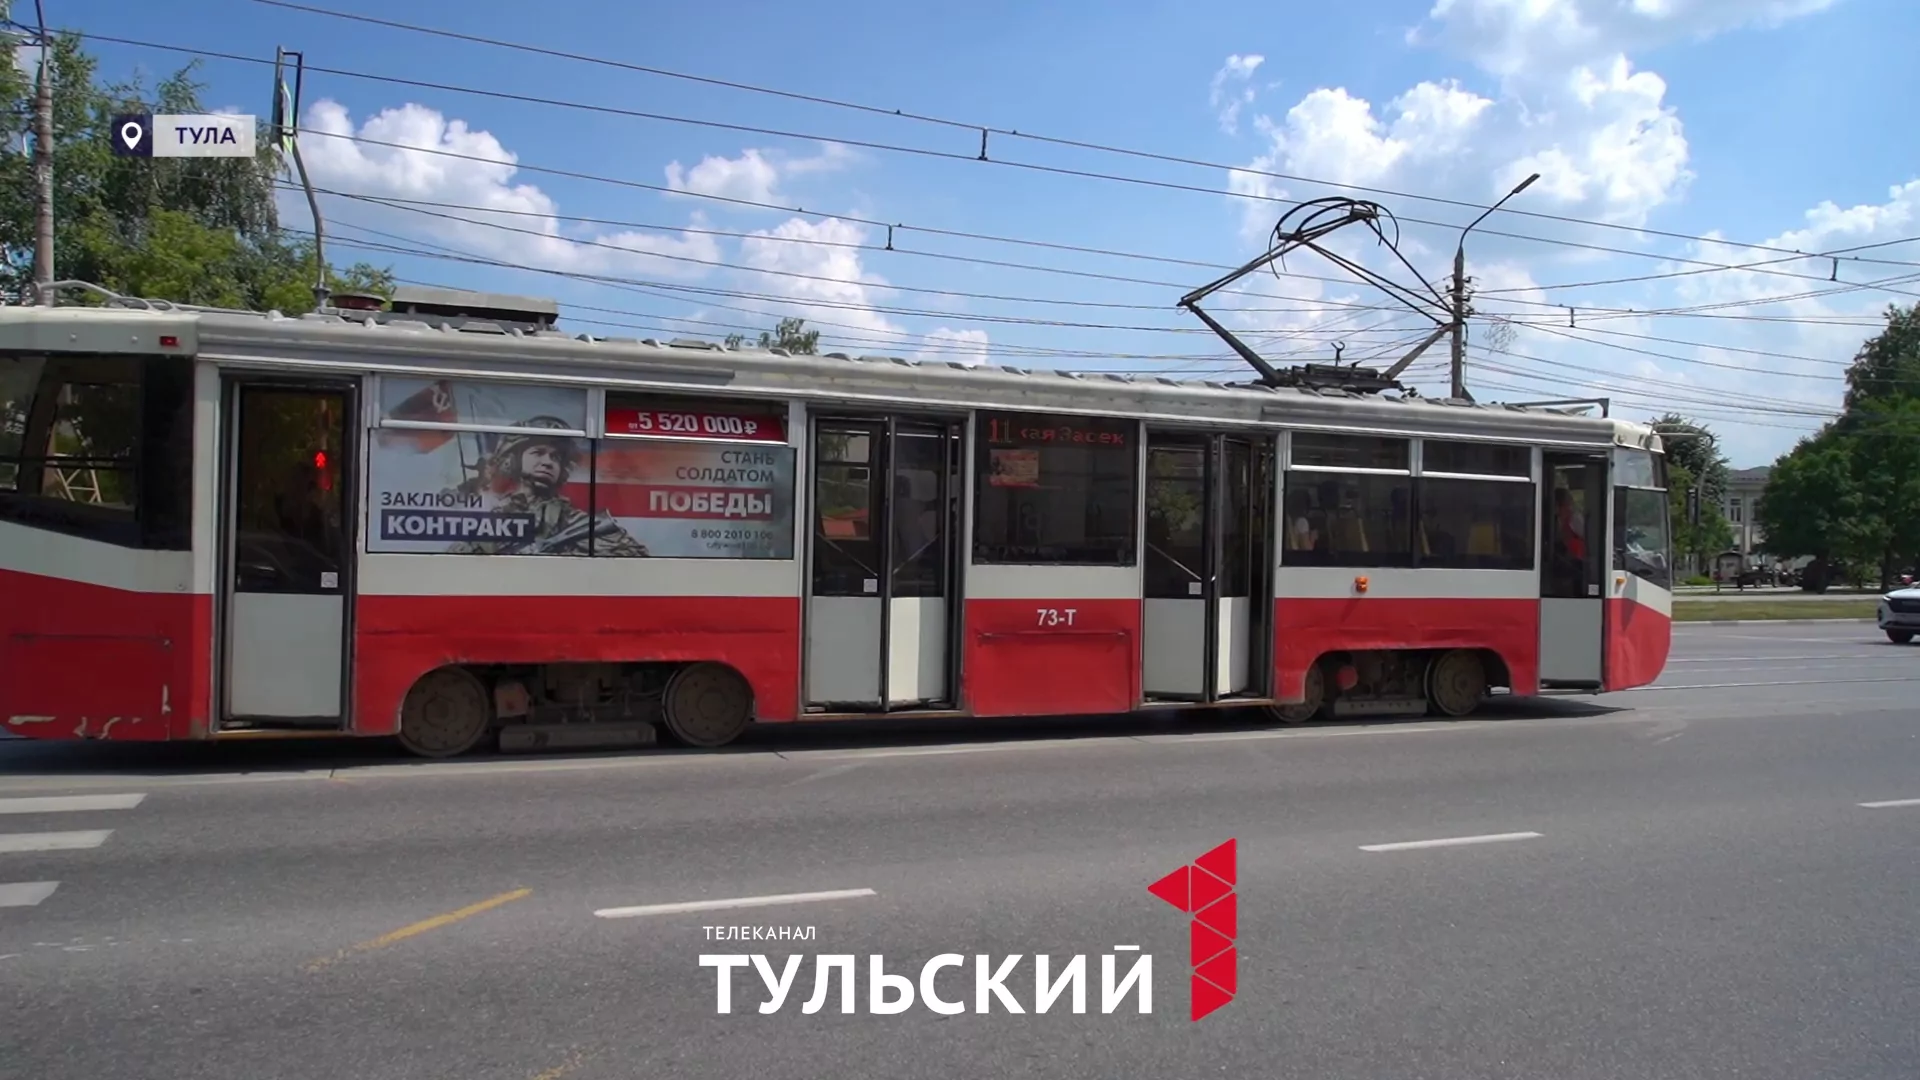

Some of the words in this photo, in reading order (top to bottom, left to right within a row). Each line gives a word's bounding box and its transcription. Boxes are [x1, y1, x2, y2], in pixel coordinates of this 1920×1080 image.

[638, 412, 652, 430] 5
[657, 413, 698, 432] 520
[989, 418, 1012, 443] 11
[721, 450, 775, 465] СТАНЬ
[676, 466, 774, 483] СОЛДАТОМ
[381, 491, 482, 508] ЗАКЛЮЧИ
[649, 490, 772, 517] ПОБЕДЫ
[387, 515, 529, 537] КОНТРАКТ
[1036, 608, 1077, 626] 73-Т
